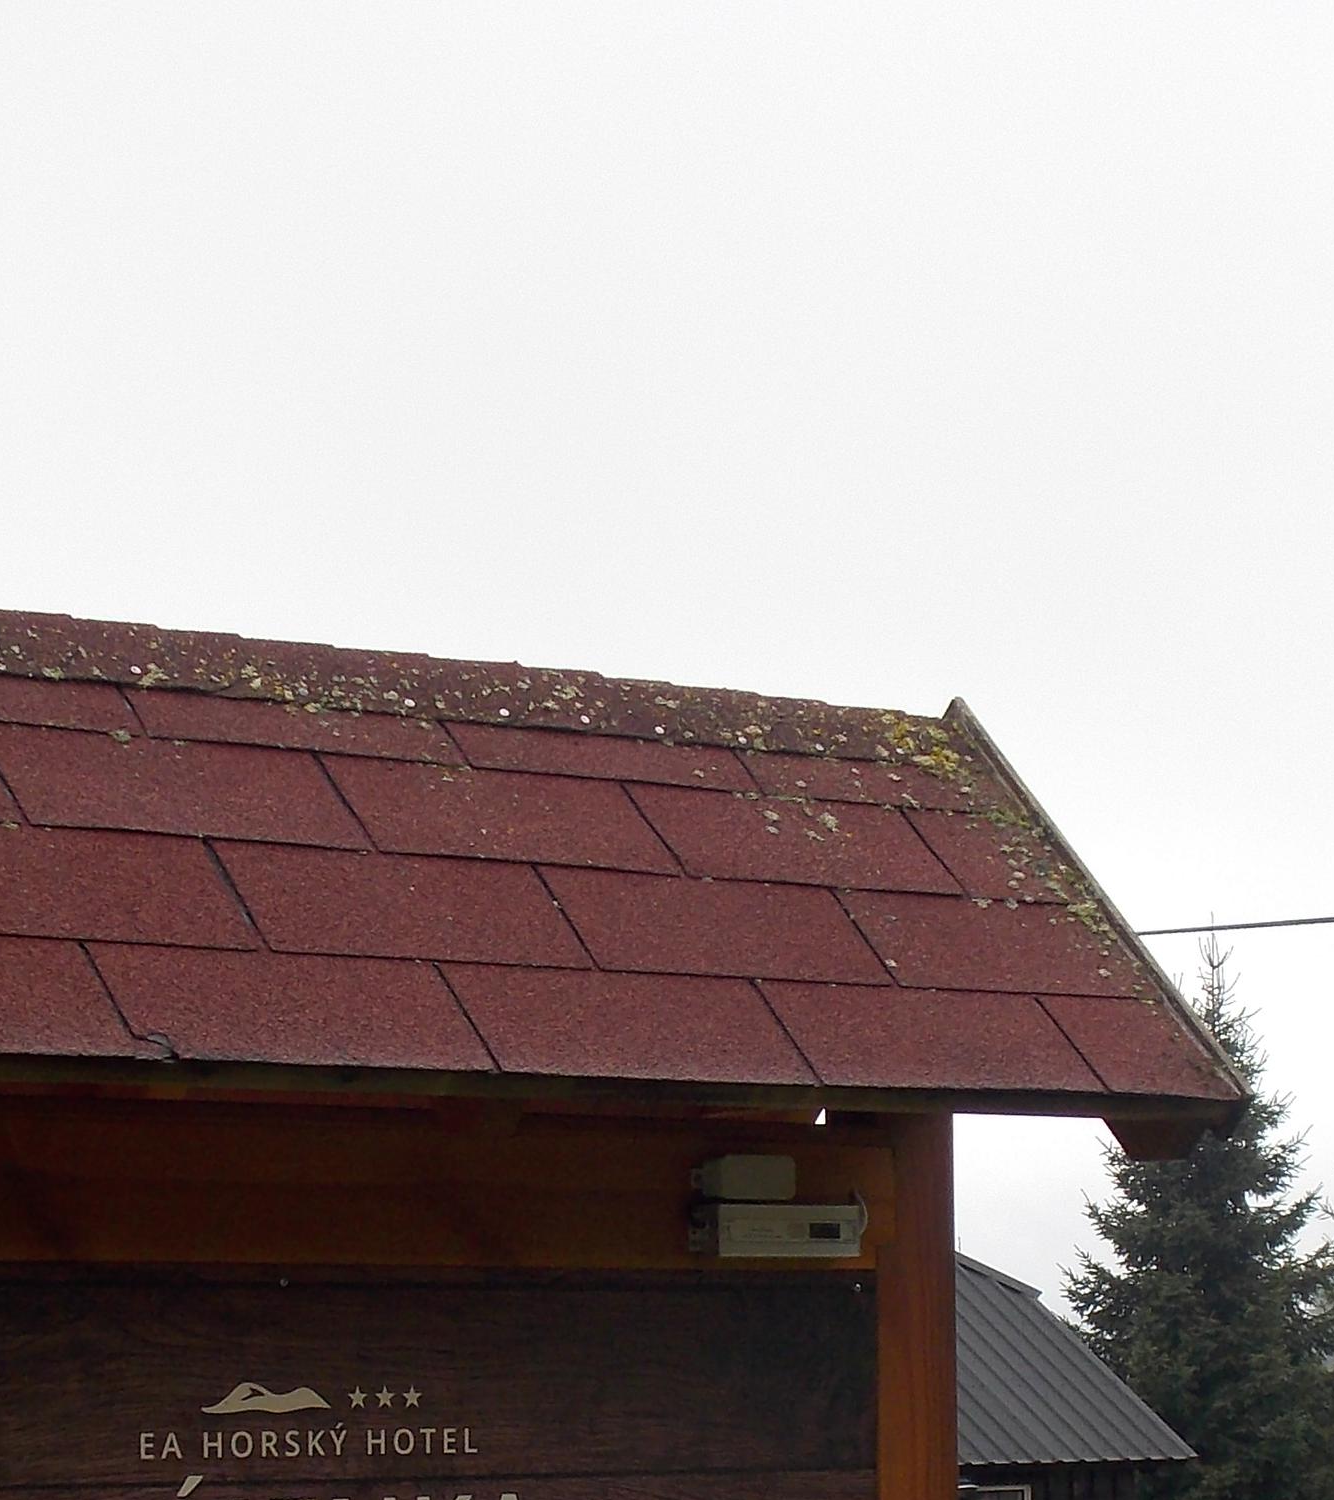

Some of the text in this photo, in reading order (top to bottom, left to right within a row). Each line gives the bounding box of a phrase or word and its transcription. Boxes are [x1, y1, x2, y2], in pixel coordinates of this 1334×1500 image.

[139, 1422, 479, 1460] EA HORSKÝ HOTEL
